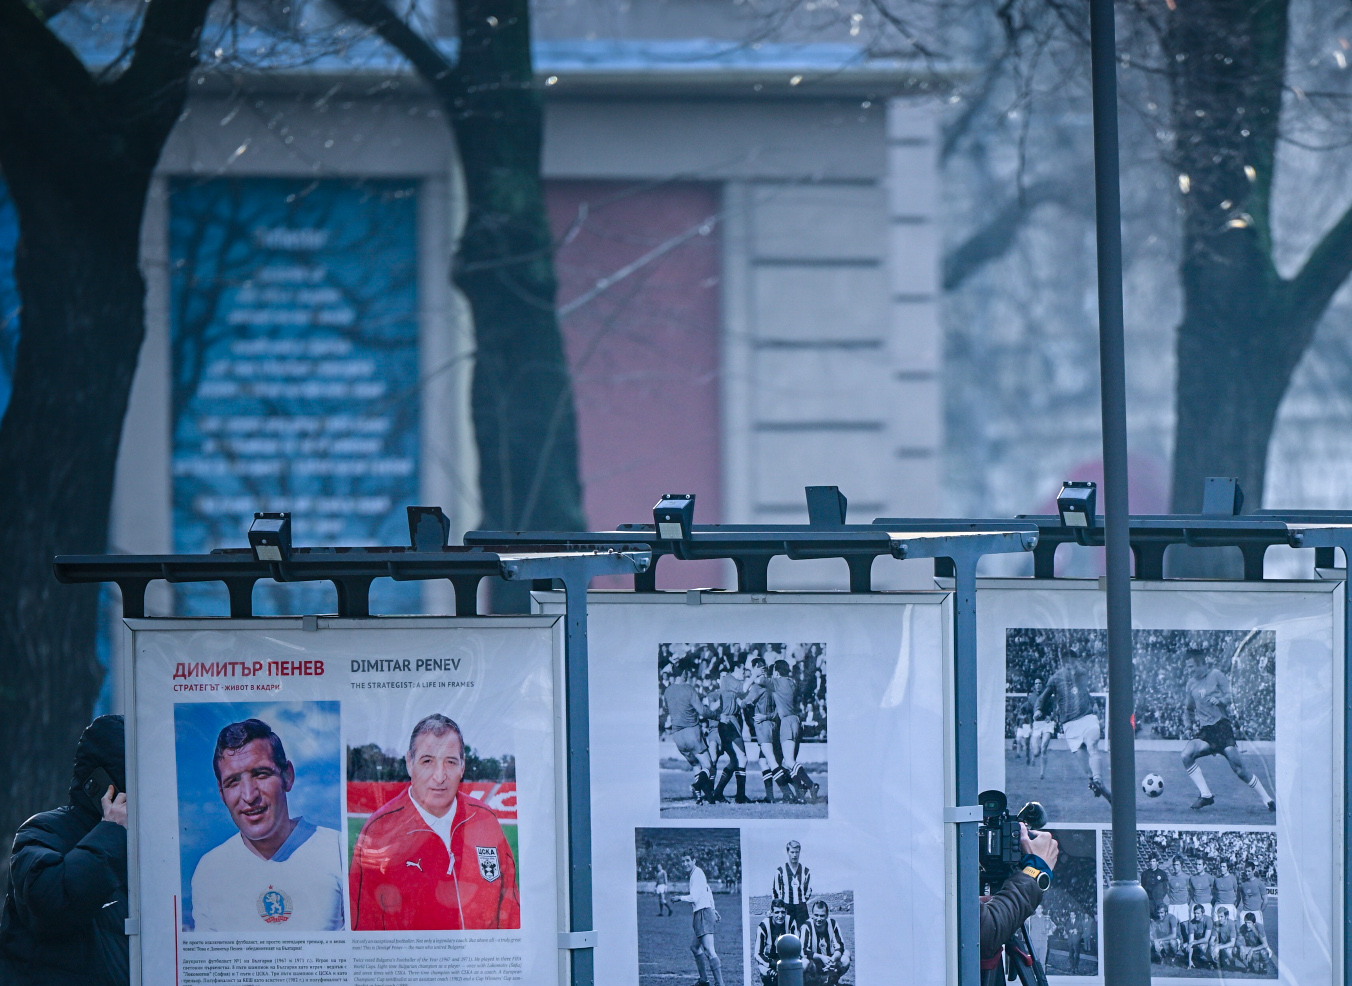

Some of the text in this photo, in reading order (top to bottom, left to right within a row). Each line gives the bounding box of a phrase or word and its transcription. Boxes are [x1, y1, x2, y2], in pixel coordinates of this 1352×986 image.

[173, 660, 325, 680] ДИМИТЪР ПЕНЕВ
[350, 658, 461, 672] DIMITAR PENEV
